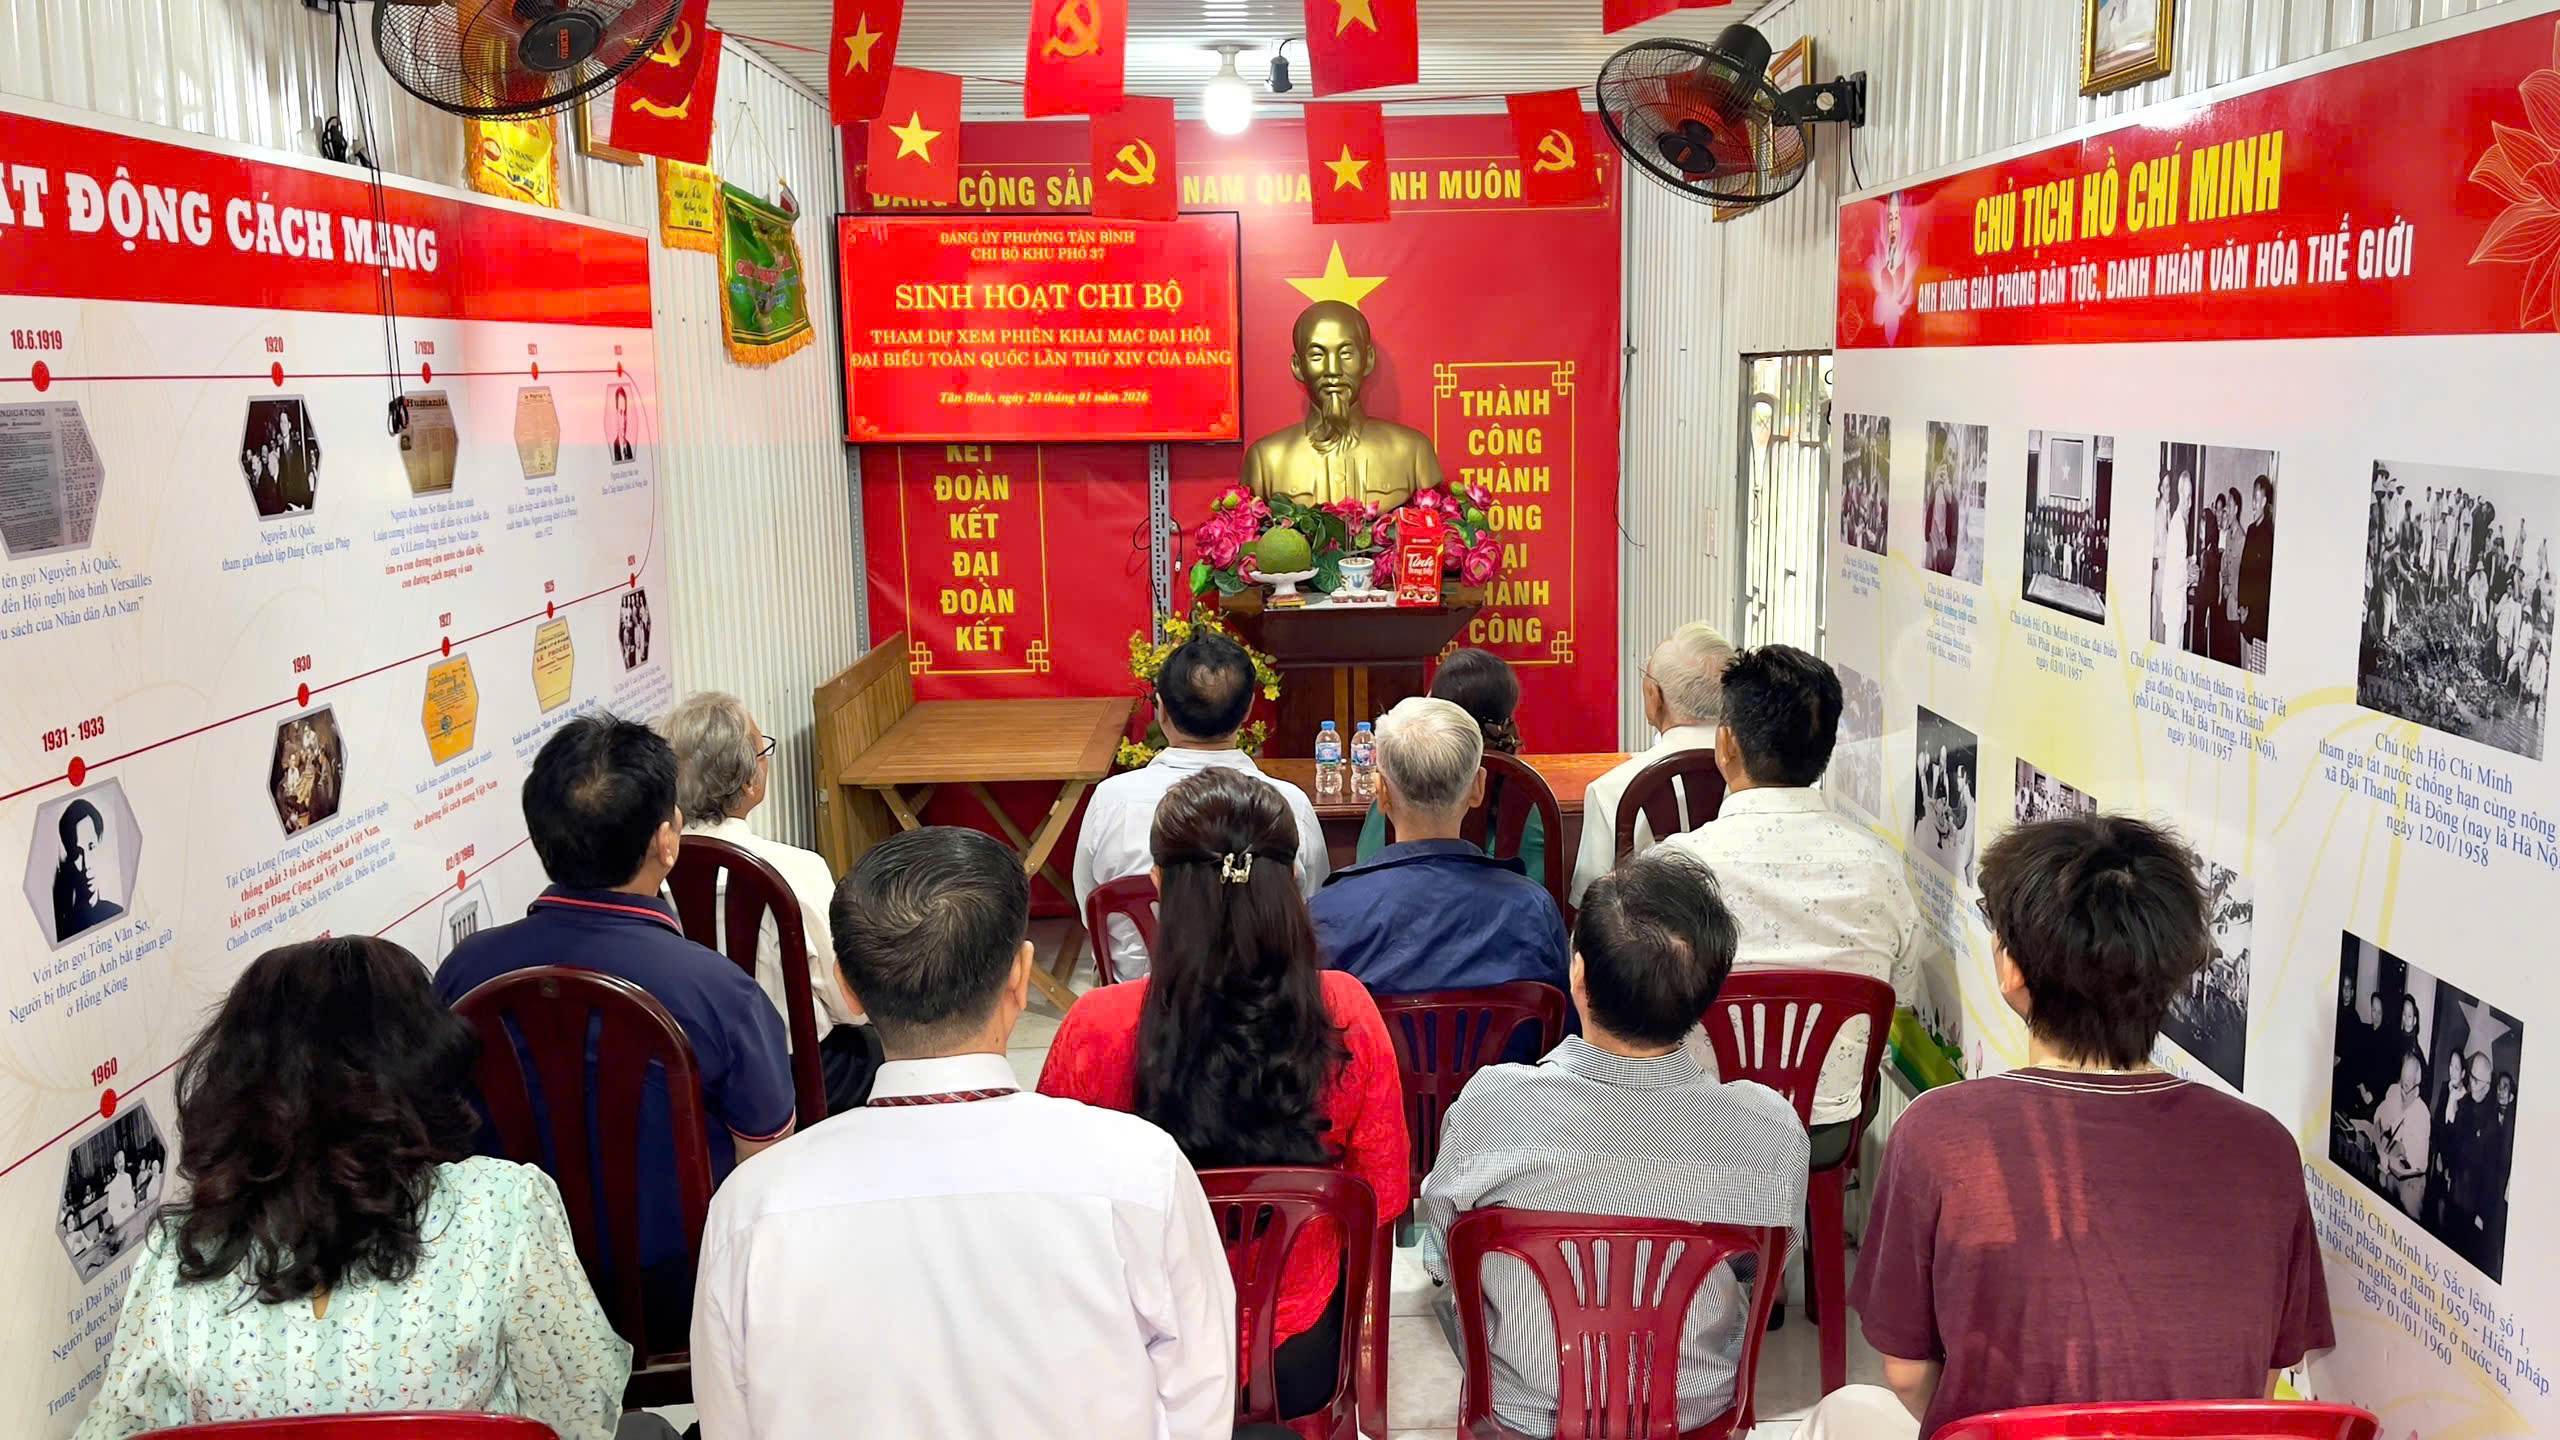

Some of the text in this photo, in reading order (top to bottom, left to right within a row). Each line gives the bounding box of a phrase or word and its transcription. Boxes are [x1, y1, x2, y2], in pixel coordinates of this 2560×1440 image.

[959, 170, 1035, 213] CỘNG
[1184, 174, 1244, 205] NAM
[1256, 172, 1312, 203] QUA
[1390, 170, 1428, 201] NH
[1439, 163, 1521, 200] MUÔN
[1974, 130, 2285, 260] CHỦ TỊCH HỒ CHÍ MINH
[65, 166, 213, 252] ĐỘNG
[226, 191, 335, 261] CÁCH
[341, 216, 439, 277] MẠNG
[940, 230, 979, 245] ĐẢNG
[1003, 229, 1064, 244] PHƯỜNG
[1068, 229, 1097, 243] TÂN
[1101, 229, 1135, 243] BÌNH
[971, 245, 1105, 262] CHI BỘ KHU PHỐ 37
[1917, 281, 1937, 313] ANH
[1939, 272, 1968, 313] HÙNG
[1970, 268, 1993, 310] GIẢI
[1996, 265, 2036, 308] PHÓNG
[2040, 259, 2066, 305] DÂN
[2106, 258, 2149, 298] DANH
[2154, 244, 2202, 295] NHÂN
[2209, 239, 2250, 290] VĂN
[2256, 229, 2299, 287] HÓA
[2307, 208, 2351, 283] THẾ
[2357, 215, 2416, 279] GIỚI
[895, 280, 1182, 315] SINH HOẠT CHI BỘ
[10, 329, 63, 351] 18.6.1919
[265, 336, 284, 353] 1920
[871, 329, 923, 344] THAM
[928, 329, 954, 345] DỰ
[956, 329, 997, 344] XEM
[1000, 327, 1055, 344] PHIÊN
[1059, 329, 1103, 344] KHAI
[1108, 329, 1145, 345] MẠC
[1180, 326, 1211, 345] HỘI
[851, 349, 1233, 368] ĐẠI BIỂU TOÀN QUỐC LẦN THỨ XIV CỦA ĐẢNG
[939, 391, 962, 403] Tân
[998, 390, 1024, 406] ngày
[1027, 391, 1041, 403] 20
[1043, 390, 1076, 405] tháng
[1078, 391, 1092, 403] 01
[1094, 391, 1119, 403] năm
[1122, 391, 1149, 402] 2026
[1459, 384, 1550, 417] THÀNH
[1468, 423, 1543, 455] CÔNG
[934, 468, 1010, 501] ĐOÀN
[1460, 461, 1550, 493] THÀNH
[950, 504, 999, 539] KẾT
[1488, 499, 1543, 531] ÔNG
[2, 572, 18, 588] tên
[21, 568, 36, 589] gọi
[39, 559, 77, 584] Nguyễn
[952, 551, 999, 582] ĐẠI
[1502, 543, 1528, 574] ẠI
[24, 593, 41, 611] Hội
[45, 588, 65, 608] nghị
[68, 586, 85, 601] hòa
[88, 580, 108, 597] bình
[111, 574, 152, 592] Versailles
[940, 582, 1015, 614] ĐOÀN
[1484, 576, 1550, 606] HÀNH
[956, 617, 1004, 651] KẾT
[1469, 612, 1543, 644] CÔNG
[292, 654, 312, 674] 1930
[2130, 651, 2144, 668] Chủ
[2147, 658, 2160, 674] tịch
[2162, 659, 2173, 678] Hồ
[2175, 665, 2188, 683] Chí
[2190, 669, 2211, 691] Minh
[2236, 688, 2245, 703] và
[2248, 692, 2268, 711] chúc
[2272, 695, 2287, 718] Tết
[41, 725, 68, 752] 1931
[78, 715, 105, 742] 1933
[2168, 726, 2185, 747] ngày
[2375, 731, 2513, 795] Chủ tịch Hồ Chí Minh
[2319, 737, 2556, 842] tham gia tát nước chống hạn cùng nông
[2325, 765, 2560, 871] xã Đại Thanh, Hà Đông (nay là Hà Nộ
[2386, 814, 2489, 868] ngày 12/01/1958
[33, 964, 52, 985] Với
[54, 959, 69, 976] tên
[72, 947, 87, 970] gọi
[88, 936, 113, 958] Tống
[114, 926, 133, 943] Văn
[90, 1056, 118, 1089] 1960
[2303, 1163, 2530, 1354] Chủ tịch Hồ Chí Minh ký Sắc lệnh số 1,
[67, 1265, 132, 1325] Tại Đại hội III
[2358, 1279, 2452, 1366] ngày 01/01/1960
